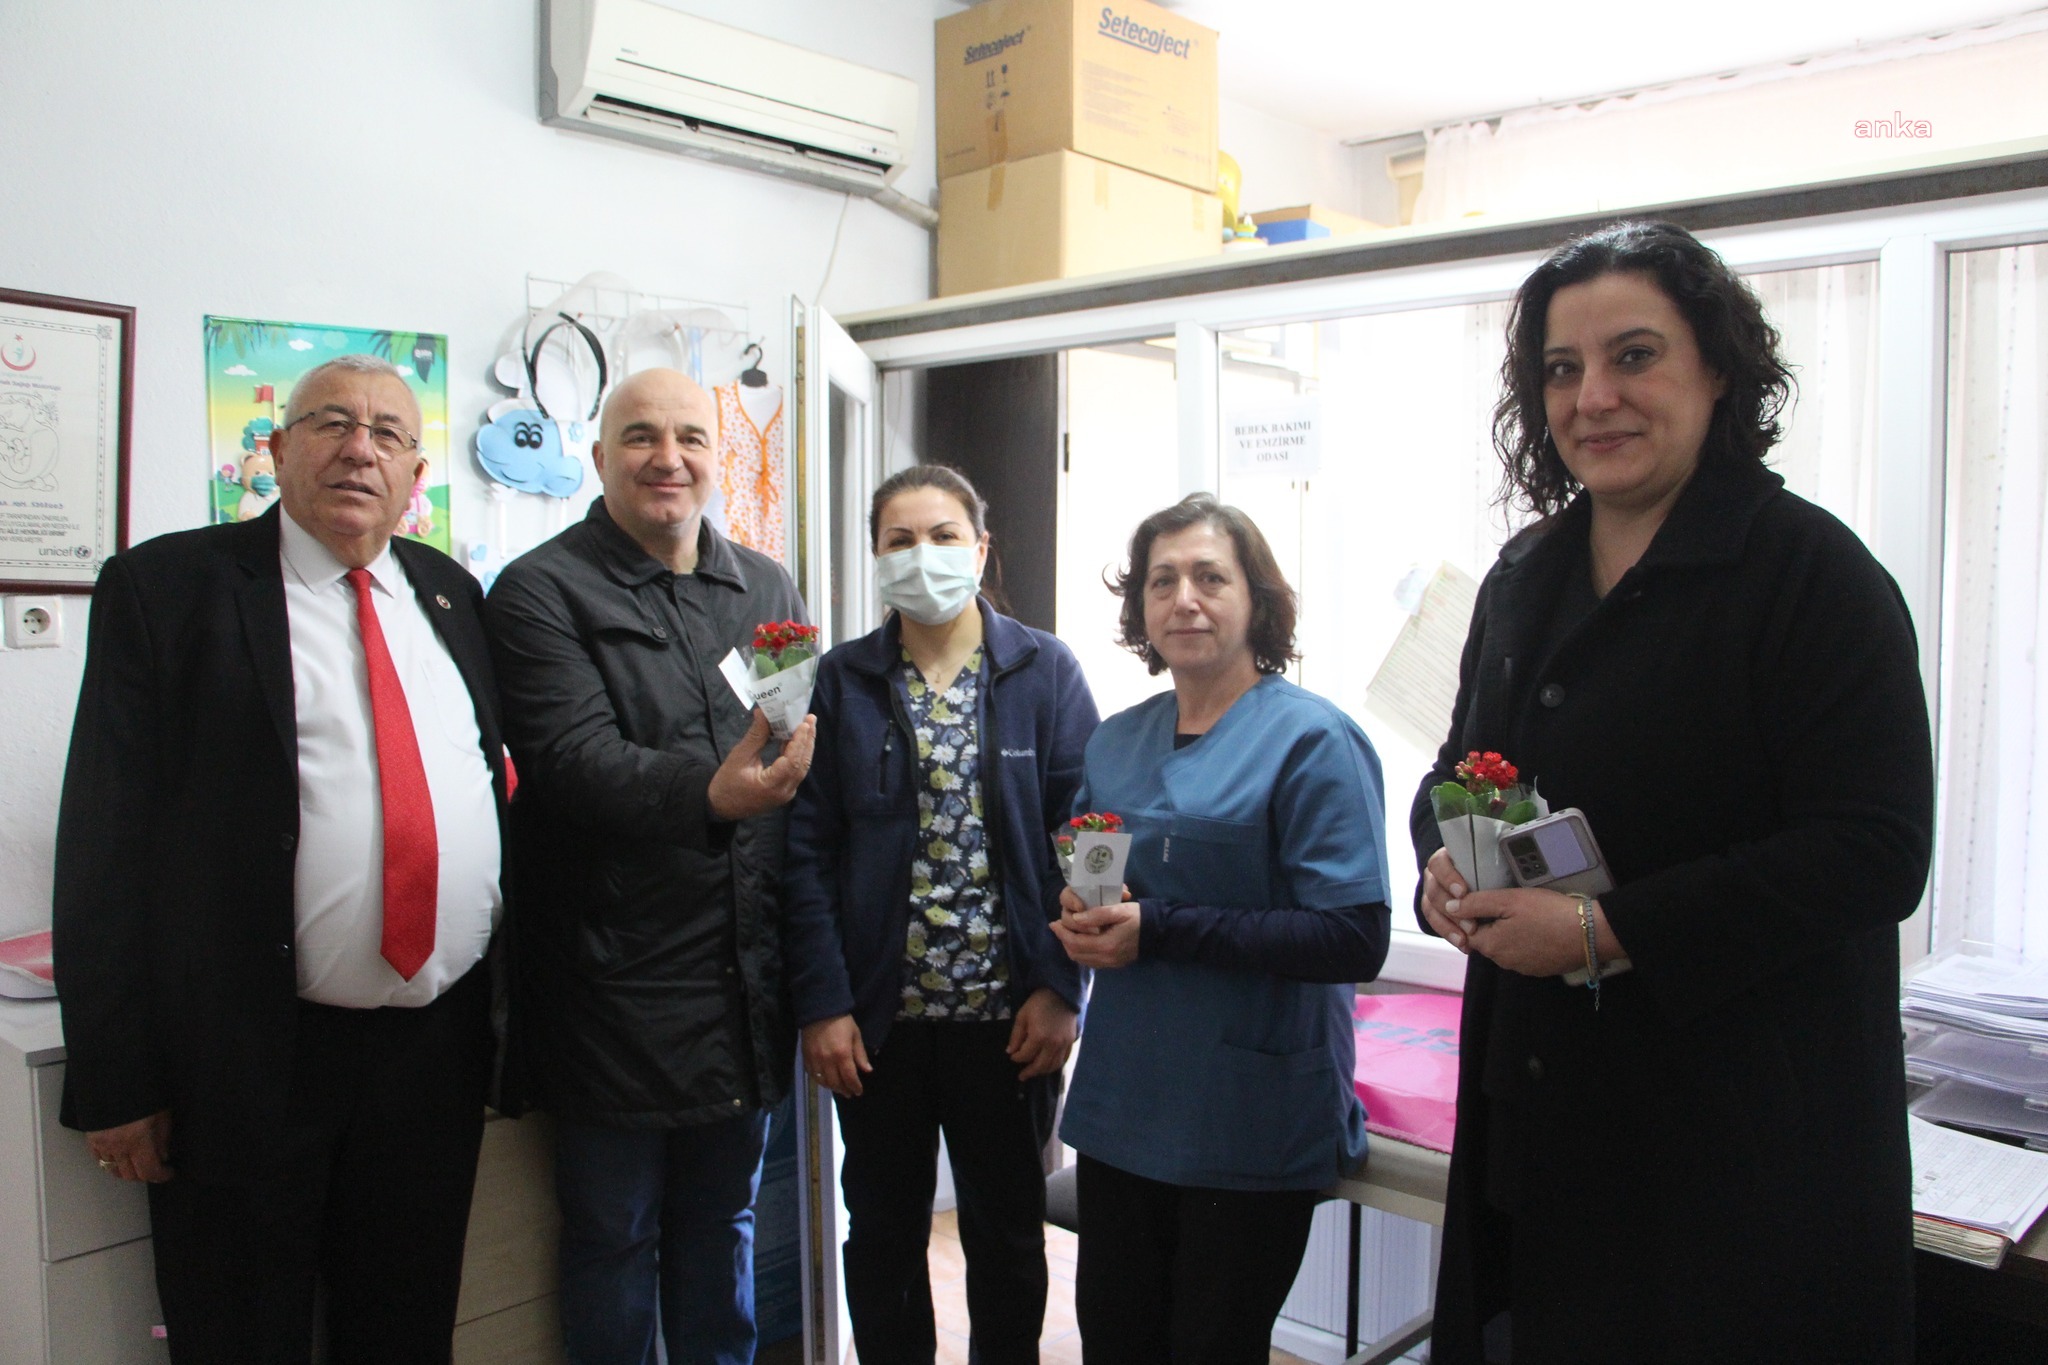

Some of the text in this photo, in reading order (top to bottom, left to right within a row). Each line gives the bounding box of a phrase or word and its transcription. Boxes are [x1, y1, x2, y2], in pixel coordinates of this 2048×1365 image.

[1098, 7, 1191, 59] Setecoject
[1234, 420, 1311, 436] BEBEK BAKIMI
[1239, 435, 1306, 449] VE EMZİRME
[1256, 450, 1288, 462] ODASI
[38, 545, 74, 556] unicef
